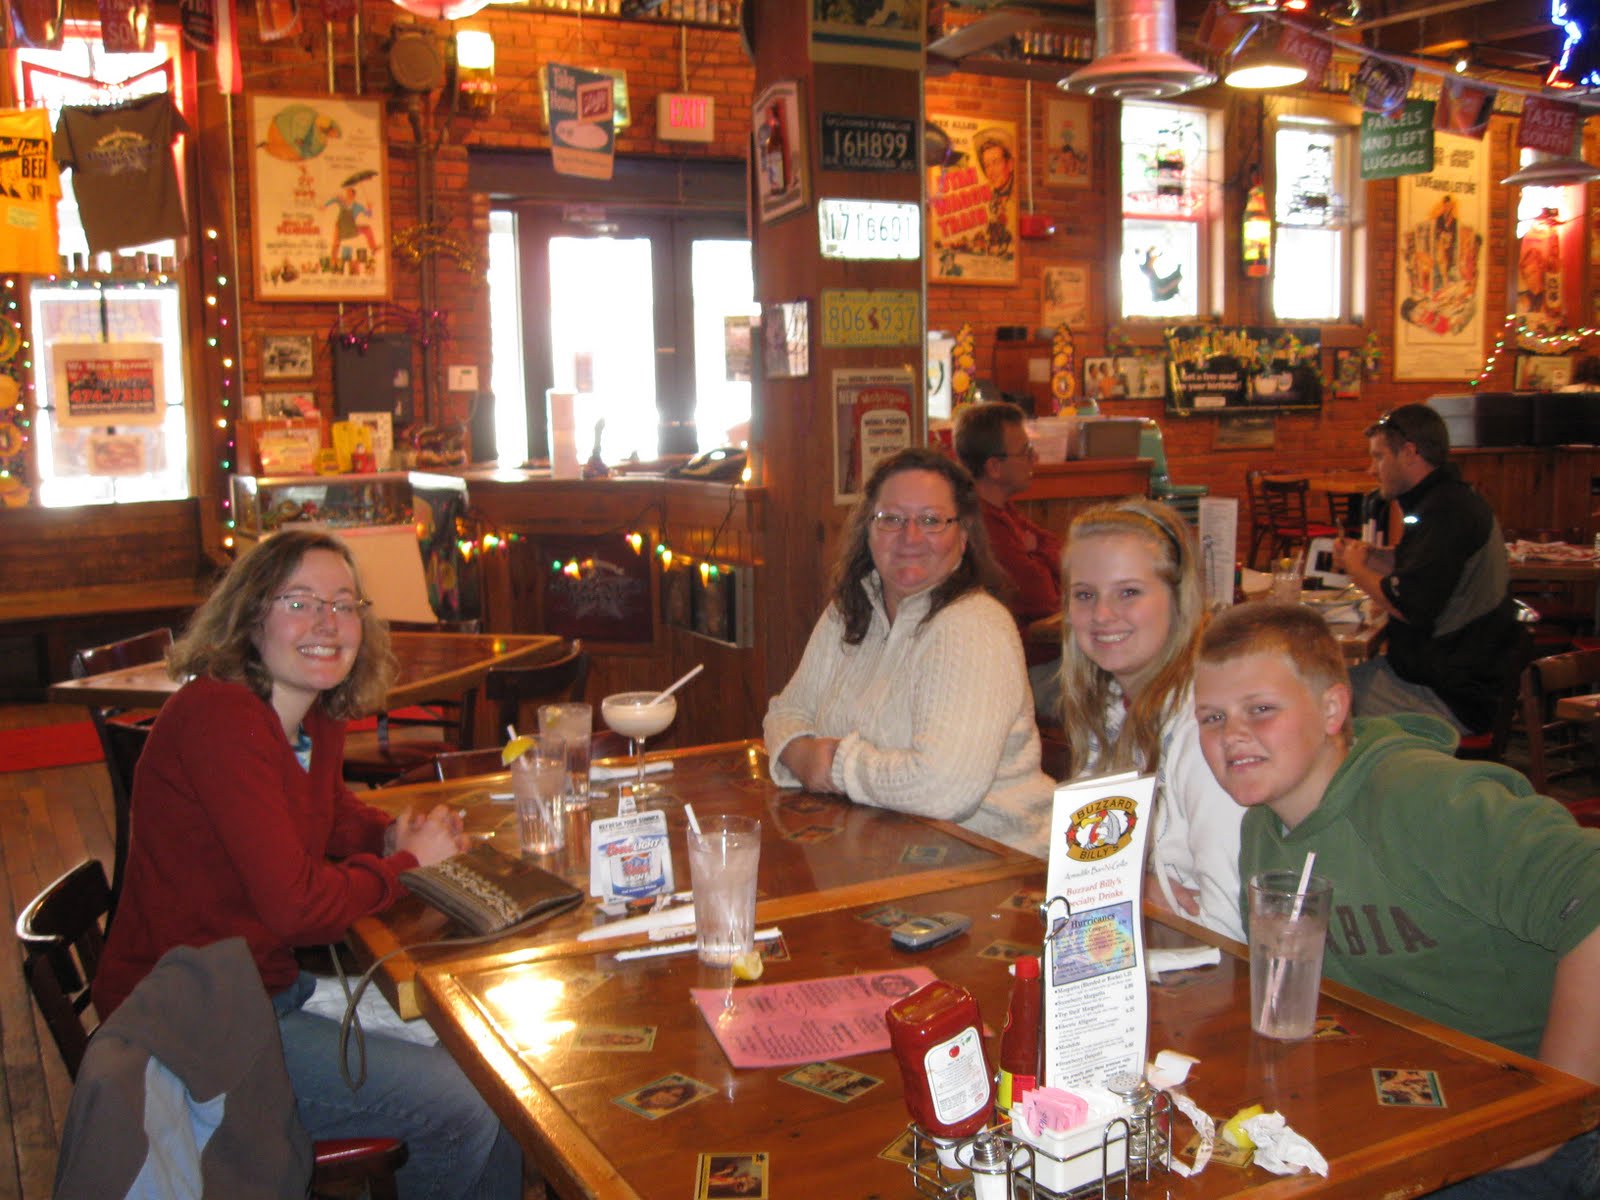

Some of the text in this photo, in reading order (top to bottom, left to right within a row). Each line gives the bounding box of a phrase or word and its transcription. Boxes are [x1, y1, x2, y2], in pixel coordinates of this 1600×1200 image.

[669, 97, 708, 129] EXIT
[1367, 110, 1423, 130] PARCELS
[1525, 108, 1576, 129] TASTE
[833, 130, 908, 159] 16H899
[1364, 130, 1427, 151] AND LEFT
[1520, 129, 1570, 152] SOUTH
[1363, 150, 1425, 171] LUGGAGE
[1077, 799, 1133, 820] BUZZARD
[633, 839, 661, 851] LIGHT
[1080, 845, 1119, 860] BILLY'S
[1066, 876, 1122, 896] Buzzard Billy's
[1098, 890, 1124, 902] Drinks
[1071, 913, 1116, 929] Hurricanes
[1325, 904, 1440, 956] BIA
